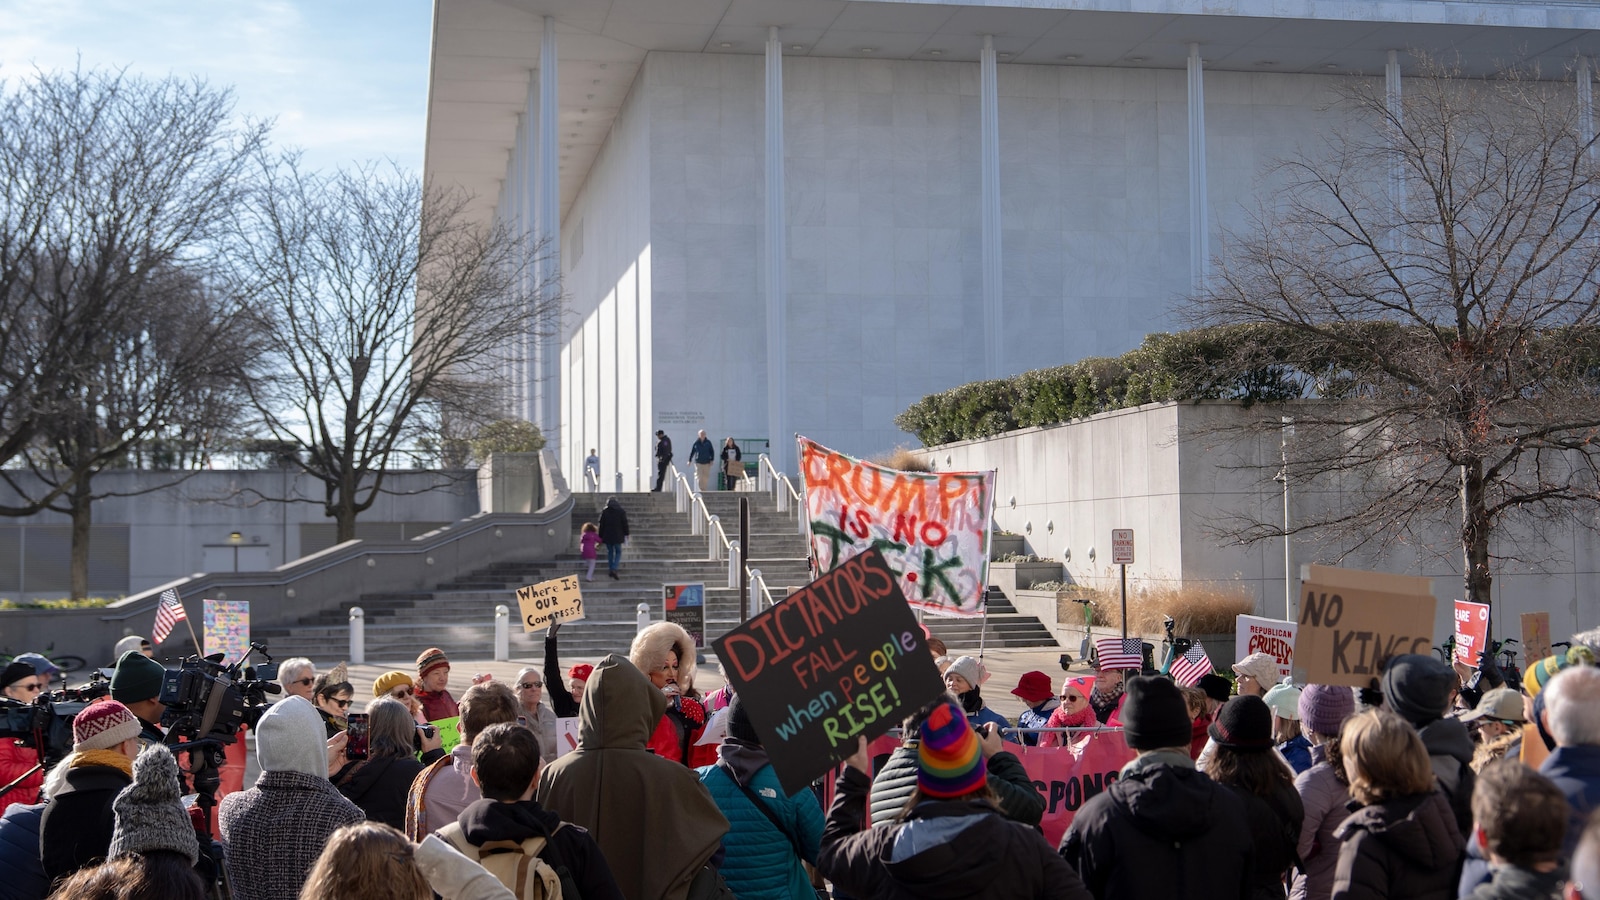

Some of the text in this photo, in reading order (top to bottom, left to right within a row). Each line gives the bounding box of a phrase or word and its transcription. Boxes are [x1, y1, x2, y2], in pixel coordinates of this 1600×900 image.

[840, 504, 948, 547] IS NO
[536, 596, 558, 610] OUR
[724, 550, 893, 682] DICTATORS
[1301, 591, 1343, 627] NO
[1249, 634, 1293, 665] CRUELTY
[1250, 625, 1292, 639] REPUBLICAN
[792, 638, 858, 689] FALL
[775, 690, 837, 741] when
[823, 677, 902, 748] RISE!
